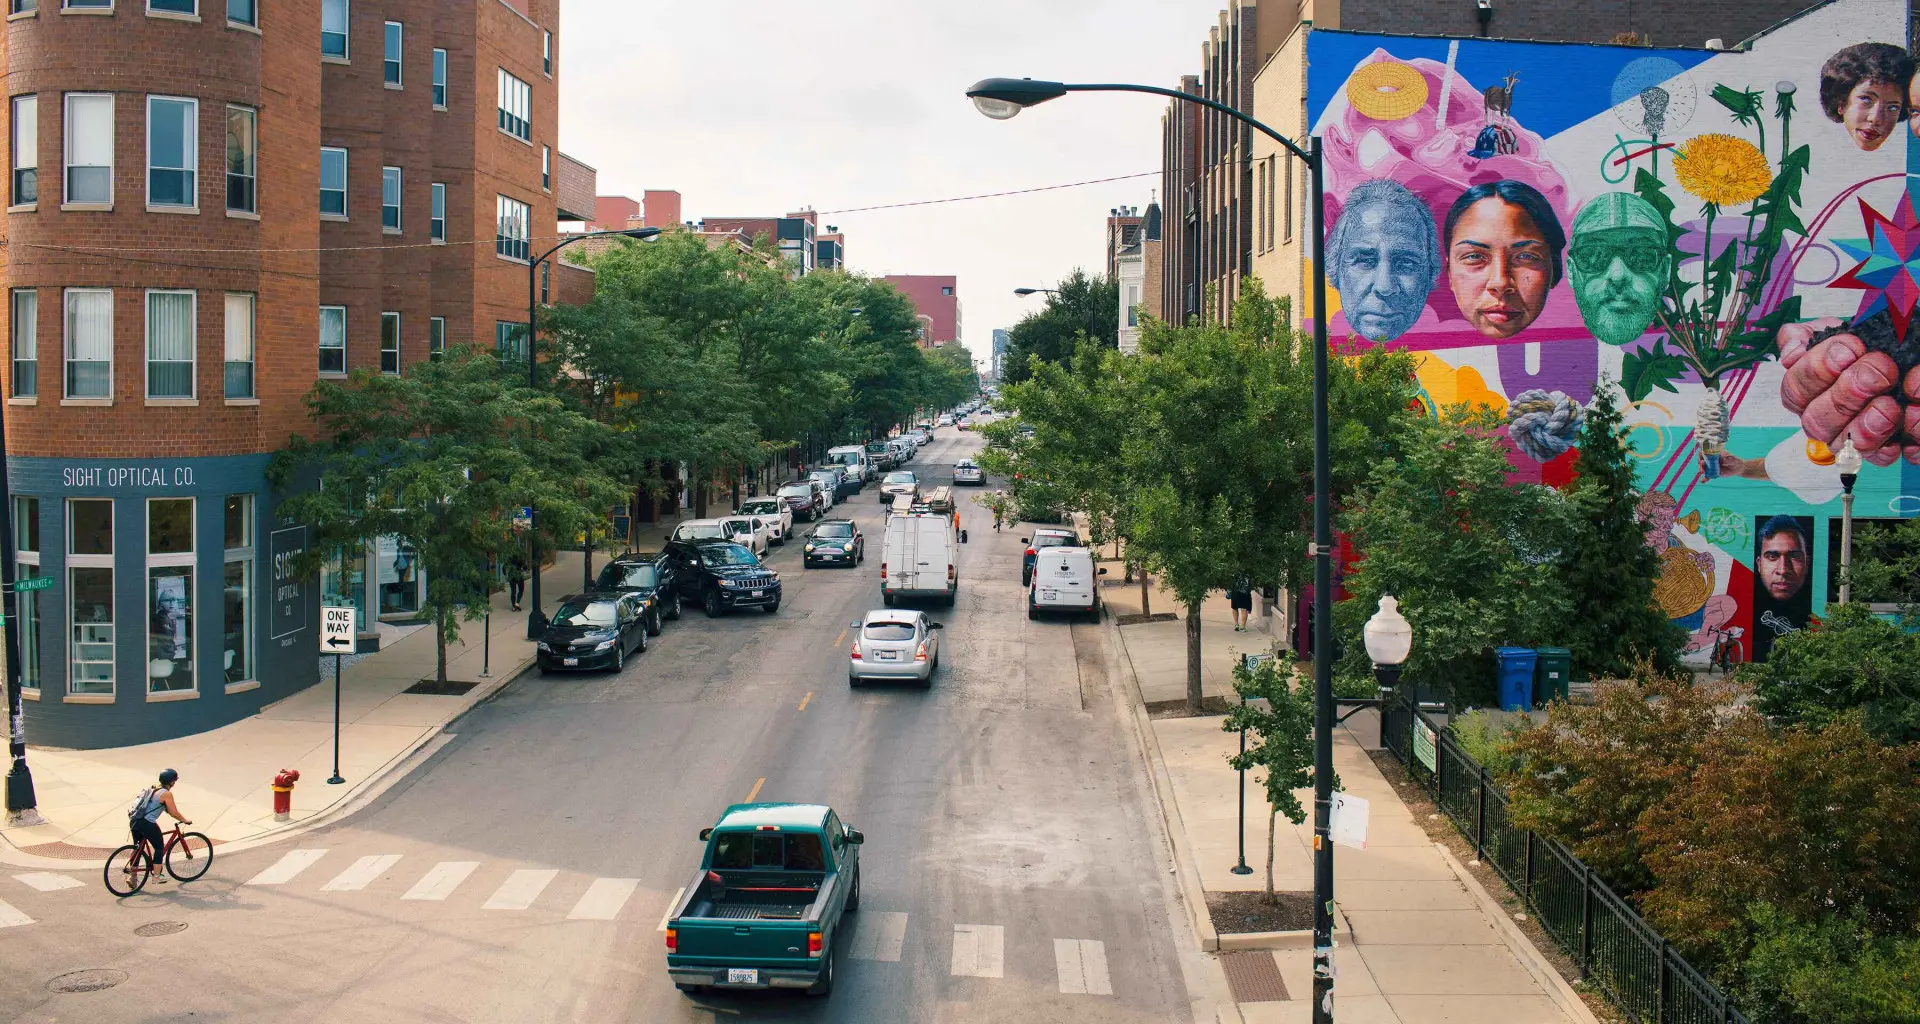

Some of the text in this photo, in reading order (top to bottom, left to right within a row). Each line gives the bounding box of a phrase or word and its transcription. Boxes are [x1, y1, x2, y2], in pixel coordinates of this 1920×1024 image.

[63, 466, 196, 487] SIGHT OPTICAL CO.
[275, 548, 303, 580] SIG
[20, 578, 48, 589] MILWAUKEE
[277, 583, 299, 602] OPTICAL
[327, 610, 349, 621] ONE
[327, 622, 349, 633] WAY
